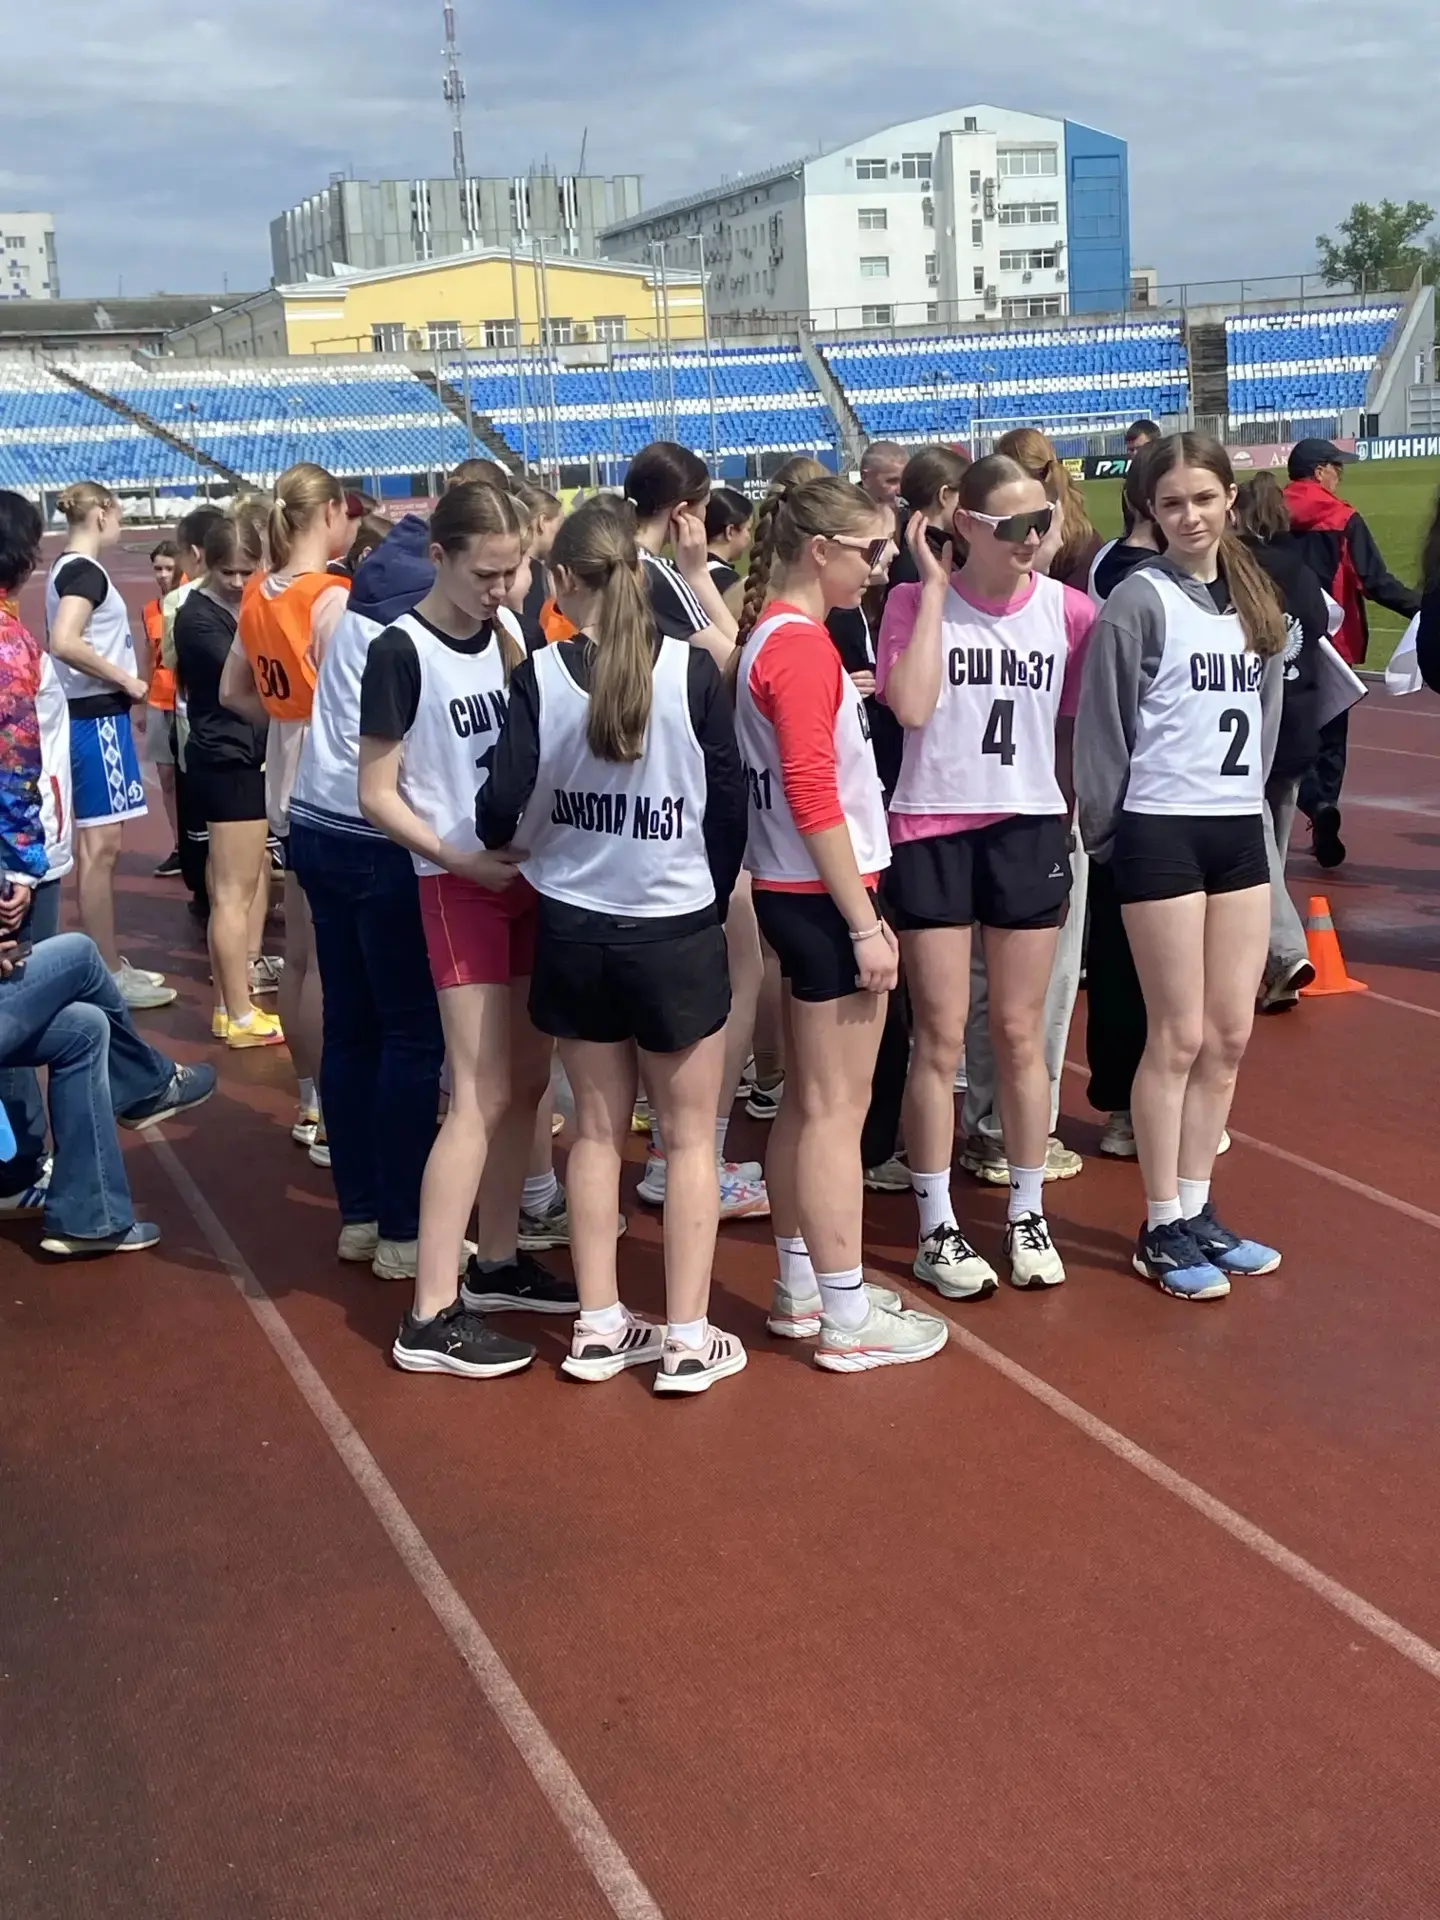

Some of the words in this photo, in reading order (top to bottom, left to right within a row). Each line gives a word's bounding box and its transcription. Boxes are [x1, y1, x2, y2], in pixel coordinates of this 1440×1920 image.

[1371, 437, 1440, 459] ШИННИ
[257, 654, 290, 700] 30
[948, 647, 993, 686] СШ
[1000, 649, 1054, 692] №31
[1190, 652, 1226, 692] СШ
[449, 692, 492, 738] СШ
[981, 699, 1016, 766] 4
[1219, 708, 1250, 776] 2
[551, 788, 627, 836] ШКОЛА
[632, 796, 684, 841] №31
